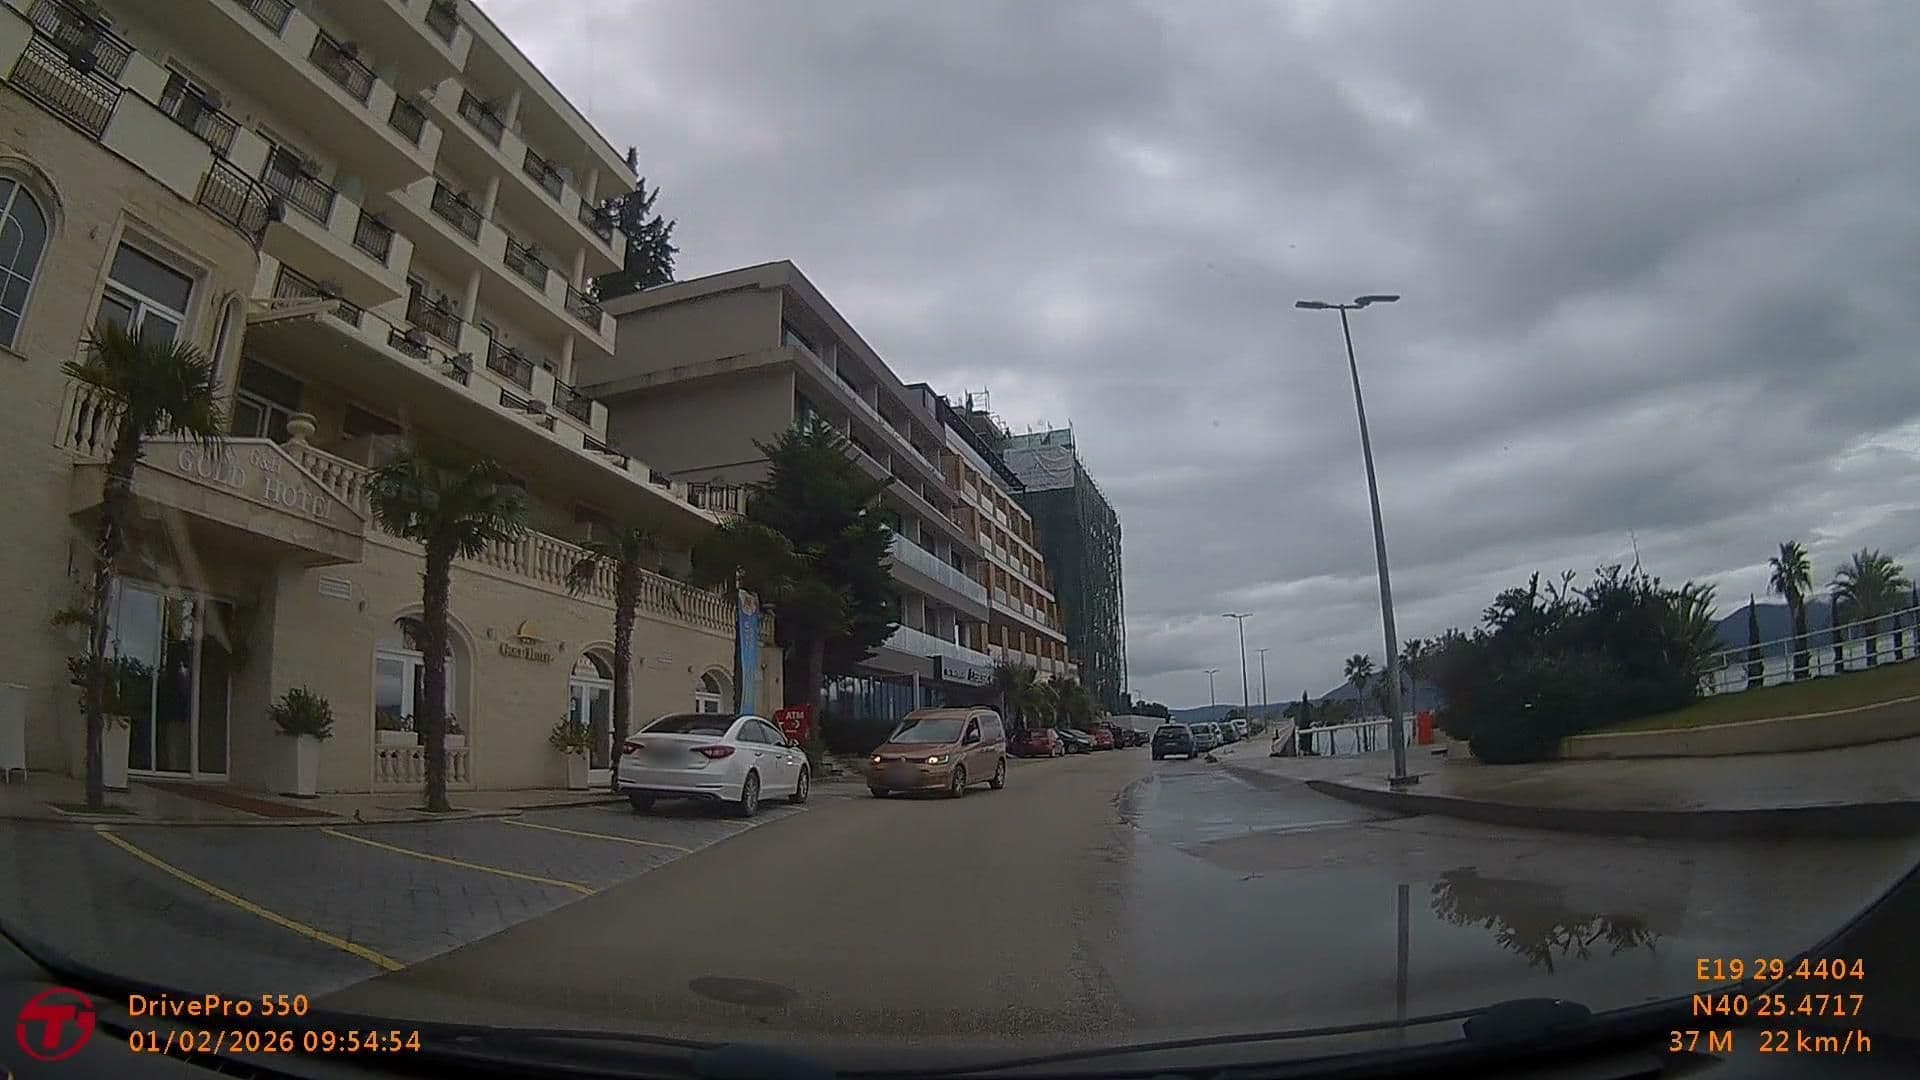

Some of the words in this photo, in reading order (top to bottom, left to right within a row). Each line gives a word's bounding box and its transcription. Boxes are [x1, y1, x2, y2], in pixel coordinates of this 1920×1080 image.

[177, 446, 247, 489] GOLD
[263, 478, 332, 519] HOTEL
[785, 711, 805, 720] ATM
